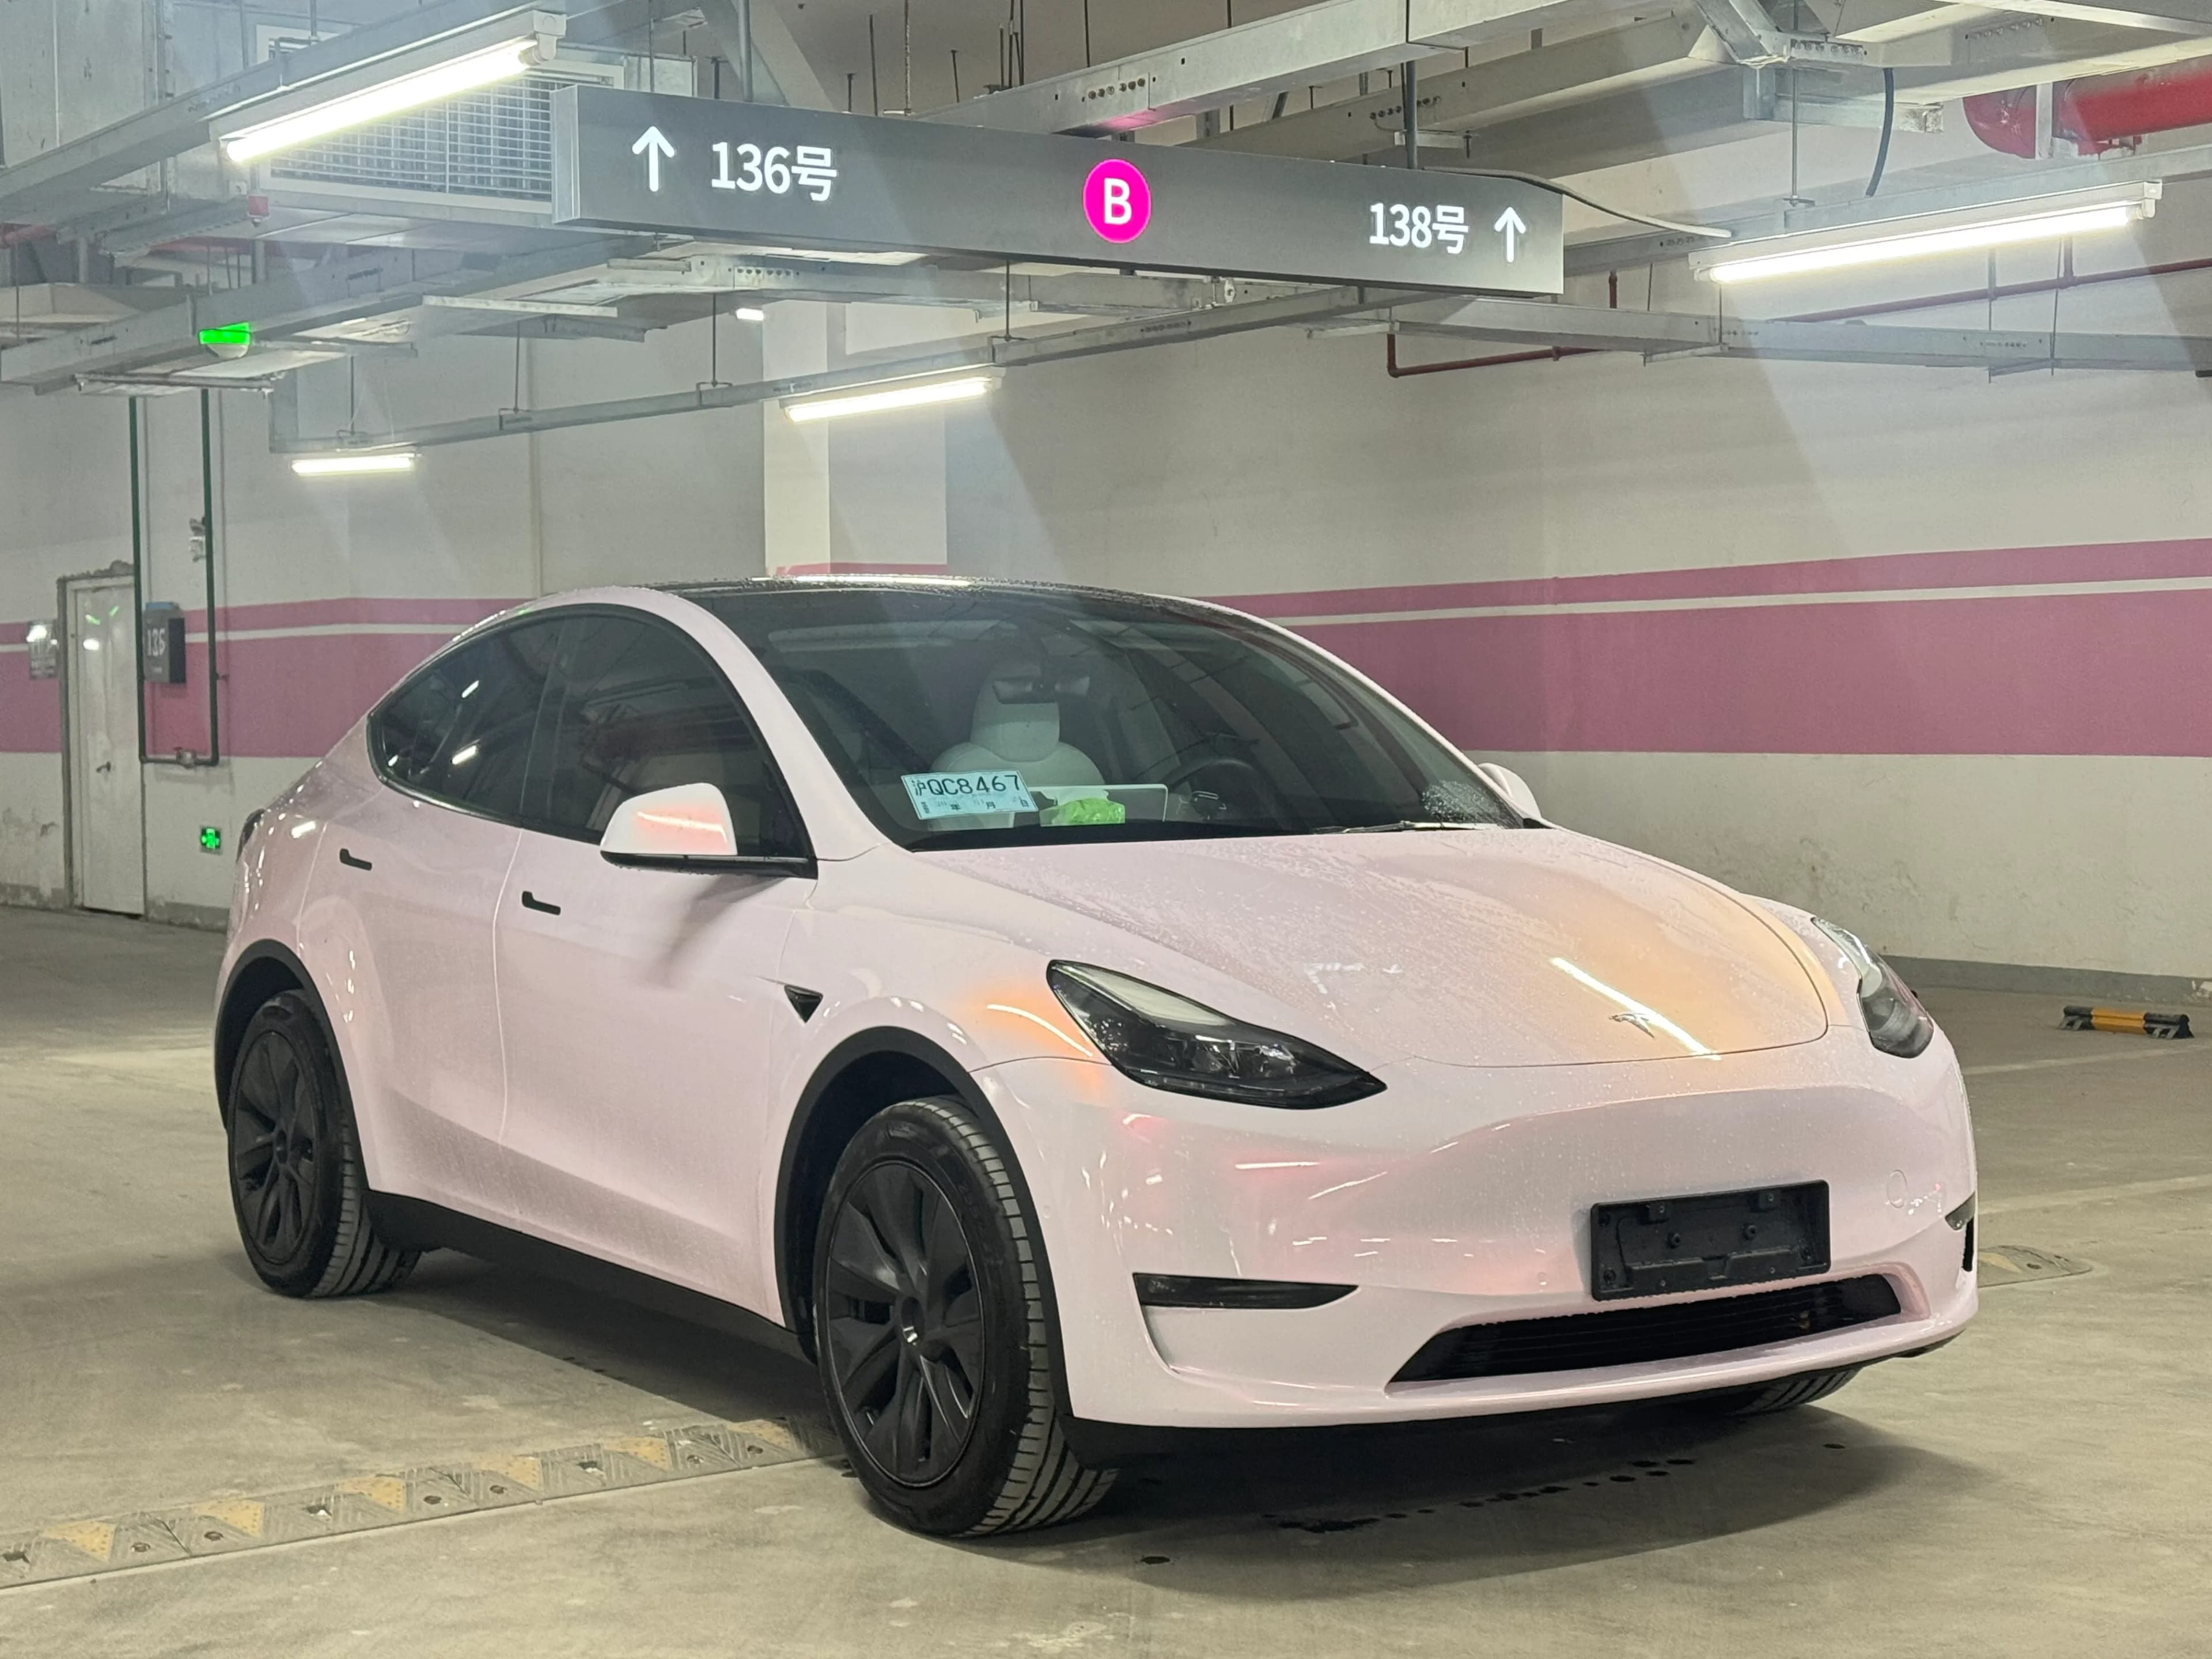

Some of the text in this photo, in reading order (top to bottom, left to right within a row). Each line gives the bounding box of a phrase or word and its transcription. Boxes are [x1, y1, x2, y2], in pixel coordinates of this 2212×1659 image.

[711, 142, 838, 202] 136号
[1104, 177, 1132, 225] B
[1369, 202, 1469, 254] 138号
[911, 774, 1020, 796] 沪QC8467
